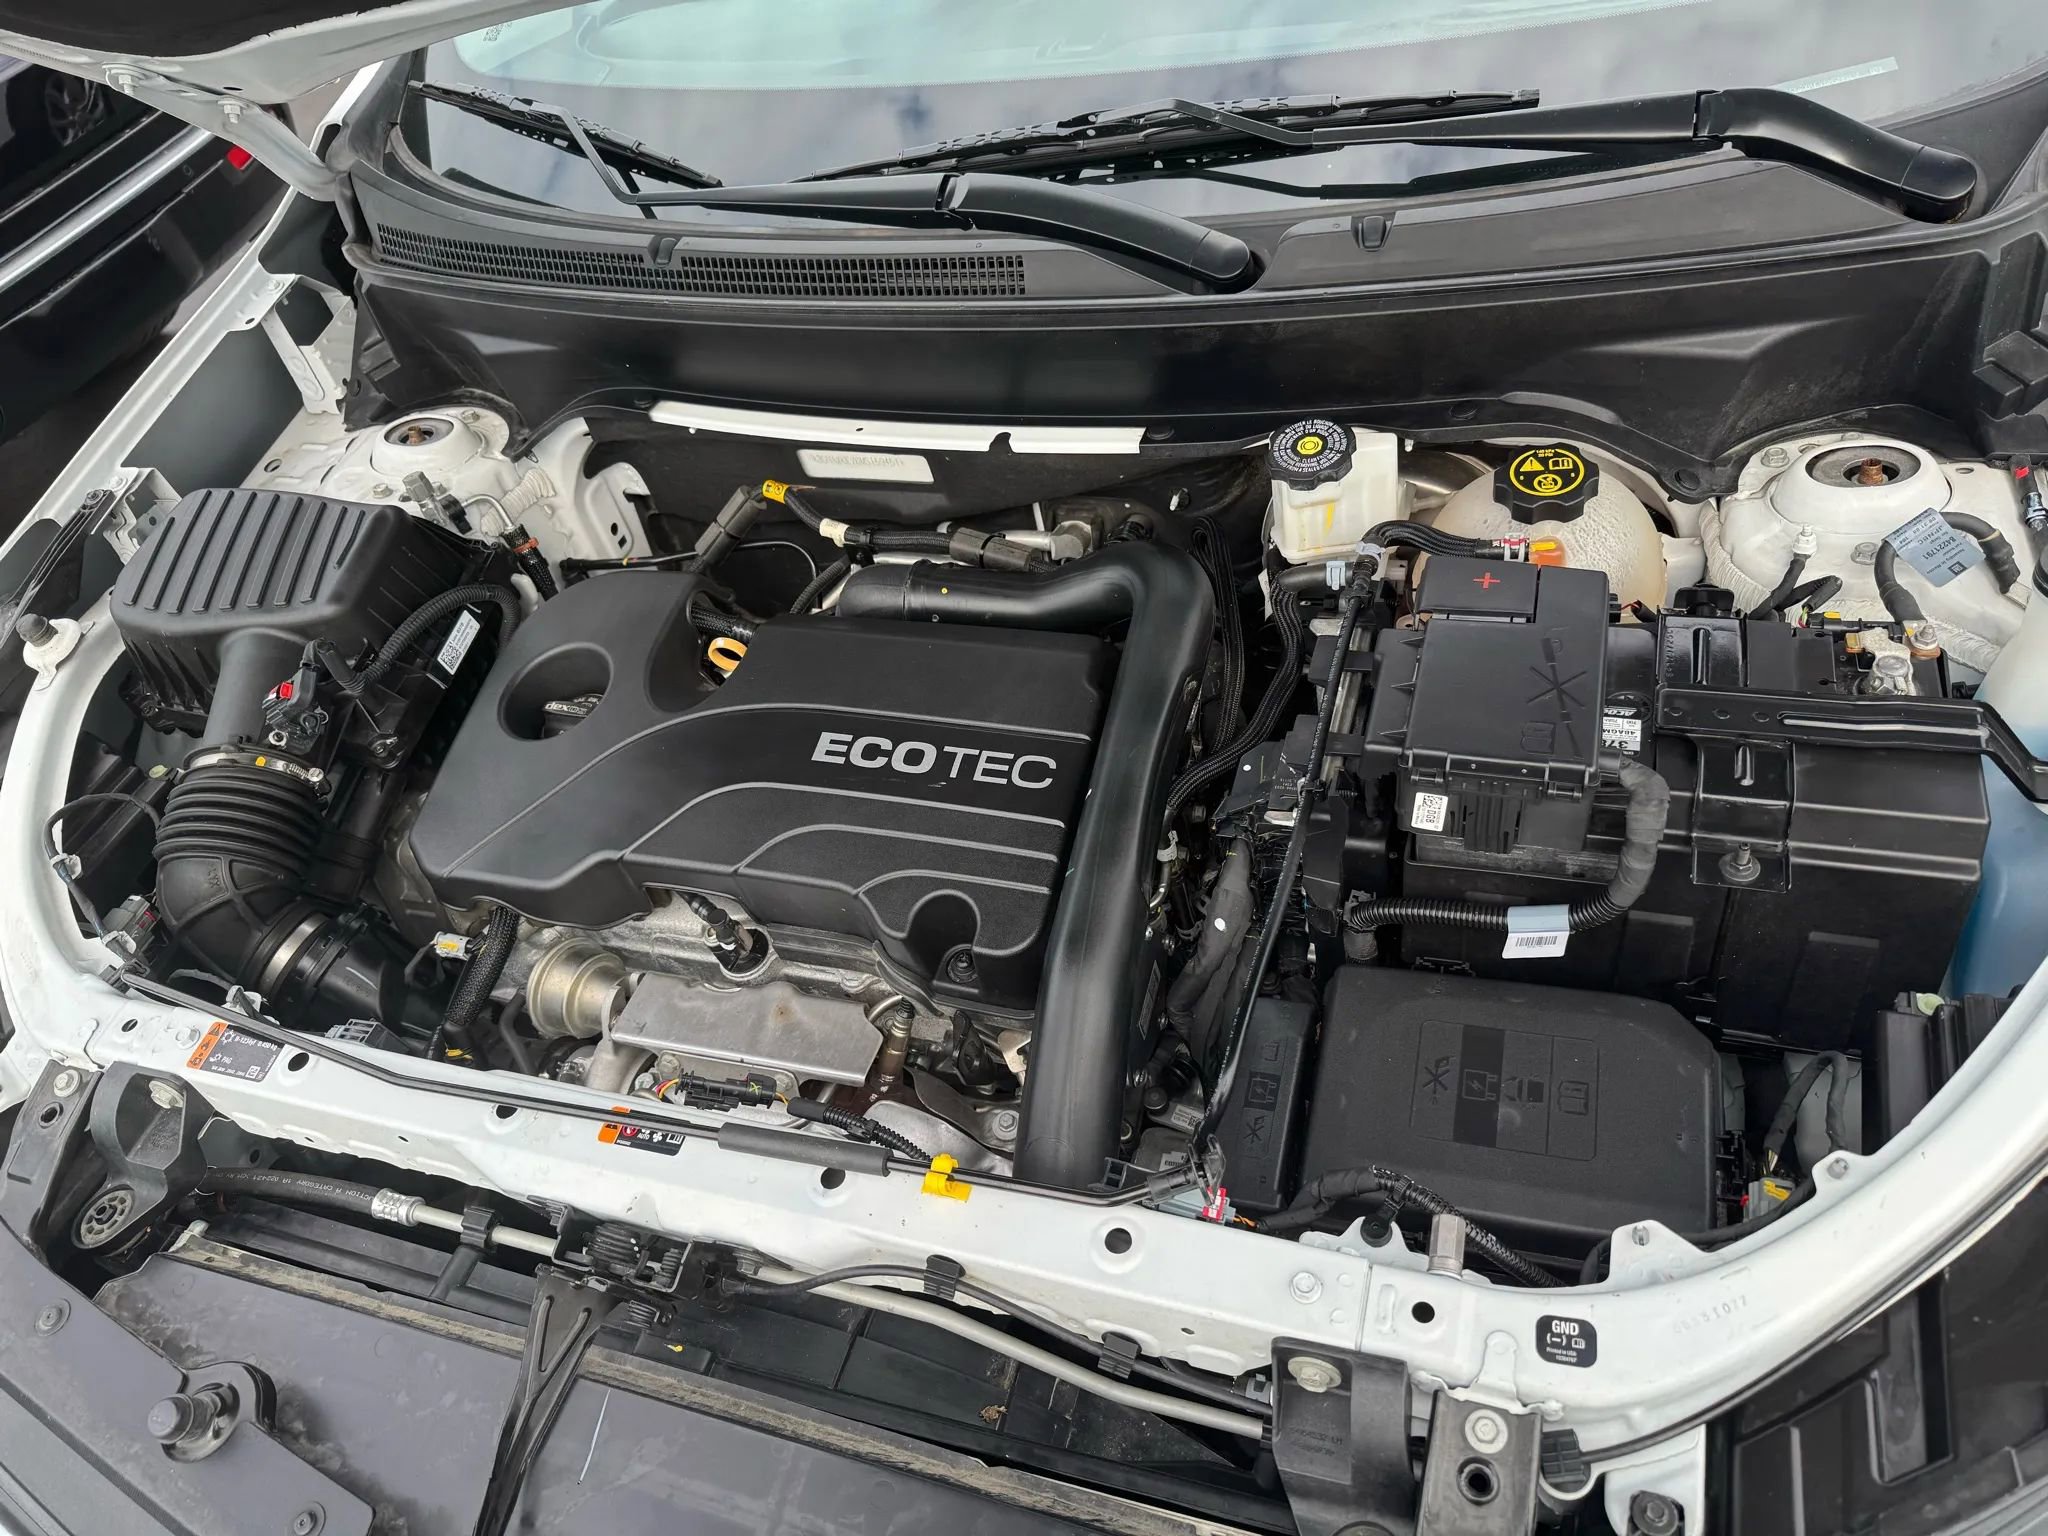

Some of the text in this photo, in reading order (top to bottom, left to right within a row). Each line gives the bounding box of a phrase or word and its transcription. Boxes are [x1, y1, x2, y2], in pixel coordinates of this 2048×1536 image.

[811, 731, 1057, 789] ECOTEC
[637, 1132, 650, 1141] AUTO
[296, 1179, 334, 1191] CATEGORY
[1552, 1320, 1579, 1335] GND
